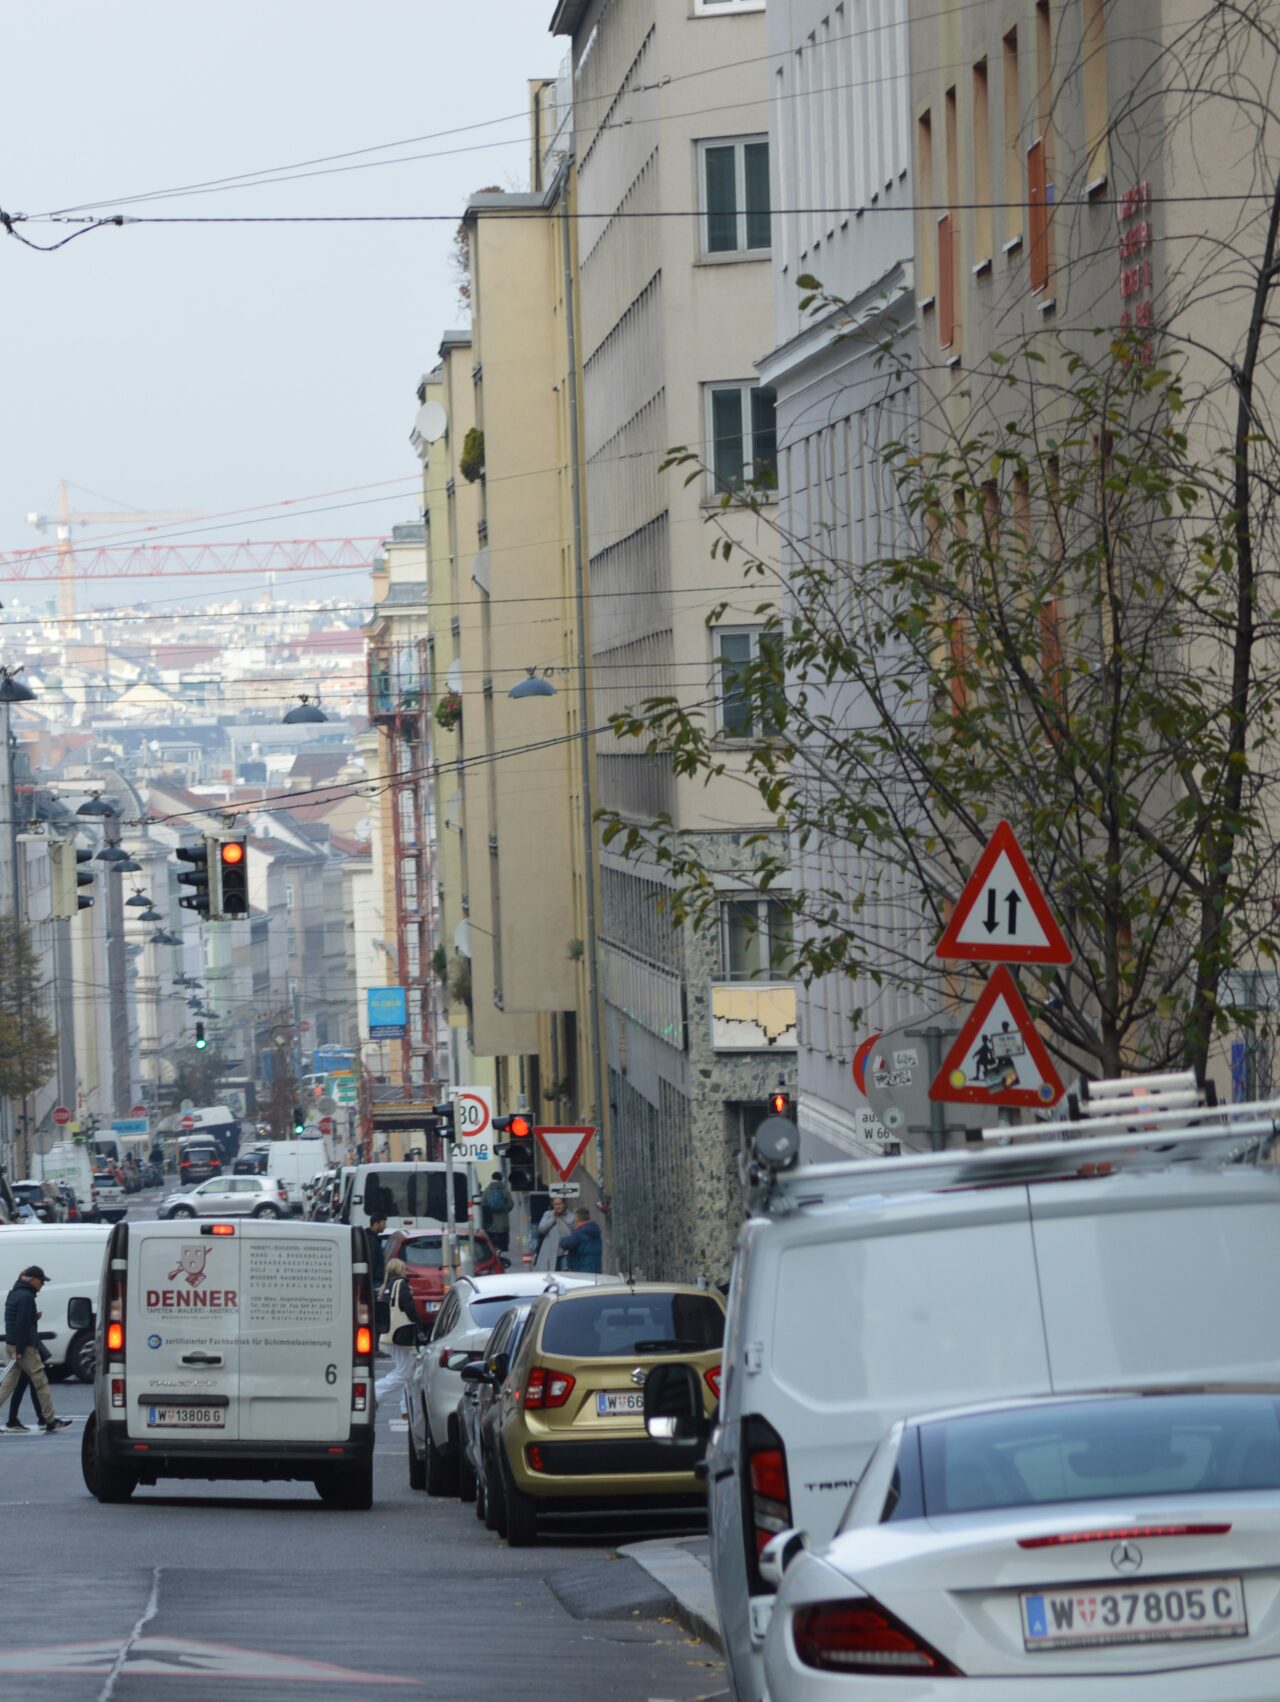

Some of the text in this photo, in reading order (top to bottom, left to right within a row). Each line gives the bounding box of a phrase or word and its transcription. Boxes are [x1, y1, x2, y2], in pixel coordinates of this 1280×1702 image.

[53, 1112, 70, 1120] STOP
[862, 1113, 880, 1123] au
[864, 1127, 873, 1139] W
[146, 1290, 238, 1307] DENNER
[165, 1337, 332, 1348] zertifizierter Fachbetrieb für Schimmelsanierung
[325, 1363, 337, 1385] 6
[607, 1396, 617, 1409] W
